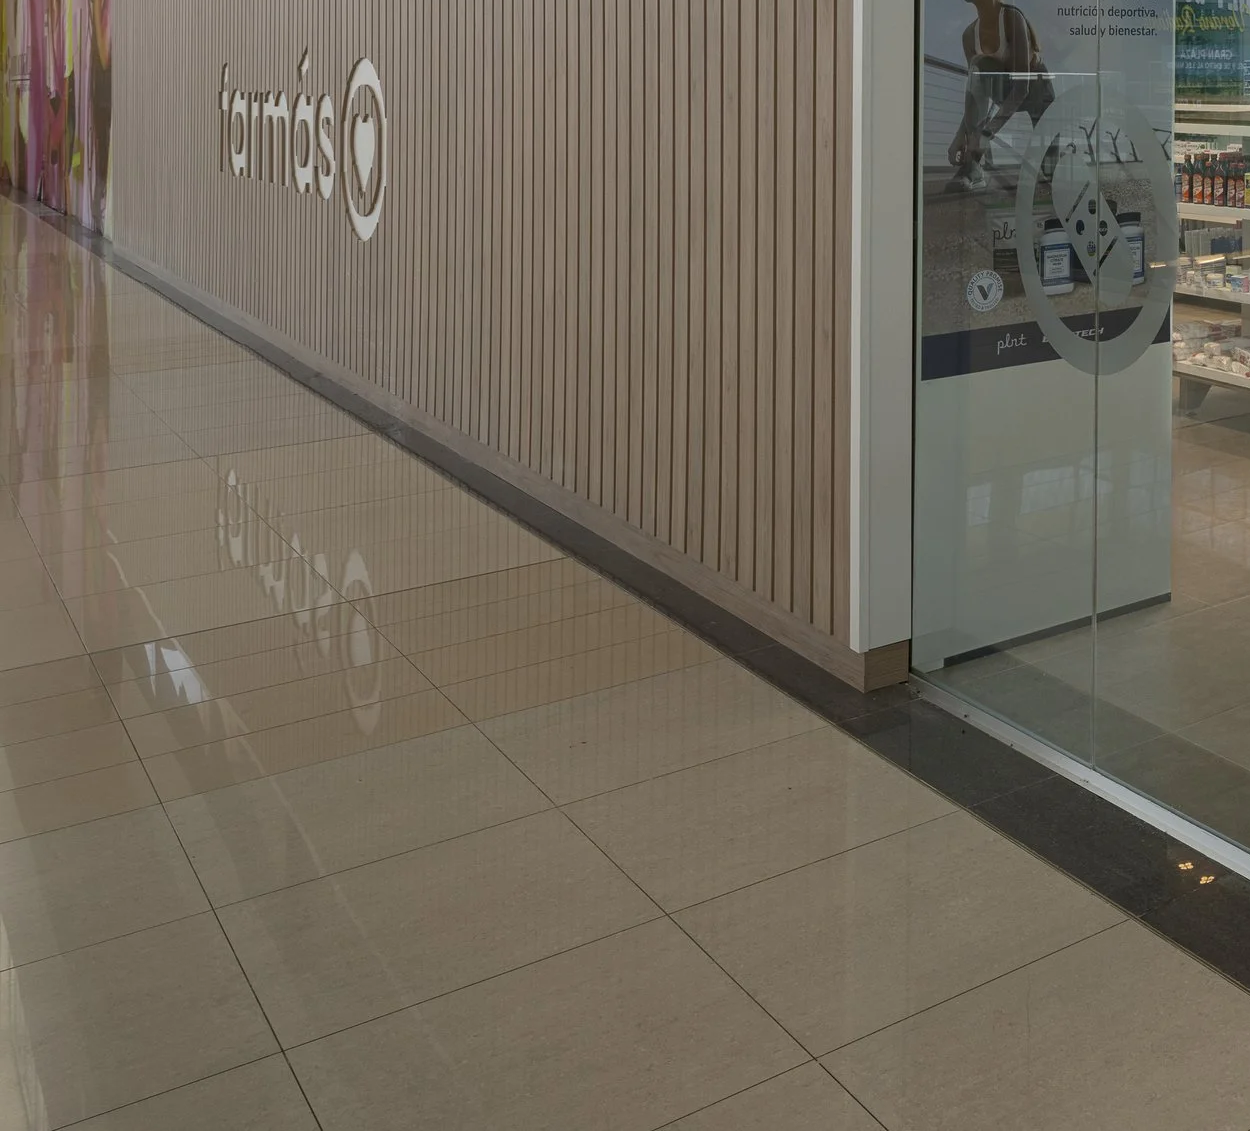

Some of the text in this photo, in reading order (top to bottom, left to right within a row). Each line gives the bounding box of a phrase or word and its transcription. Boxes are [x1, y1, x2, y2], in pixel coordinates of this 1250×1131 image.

[1057, 5, 1158, 19] nutrición deportiva,
[1069, 24, 1158, 37] salud y bienestar.
[217, 45, 336, 201] farmás
[967, 271, 984, 296] QUALITY
